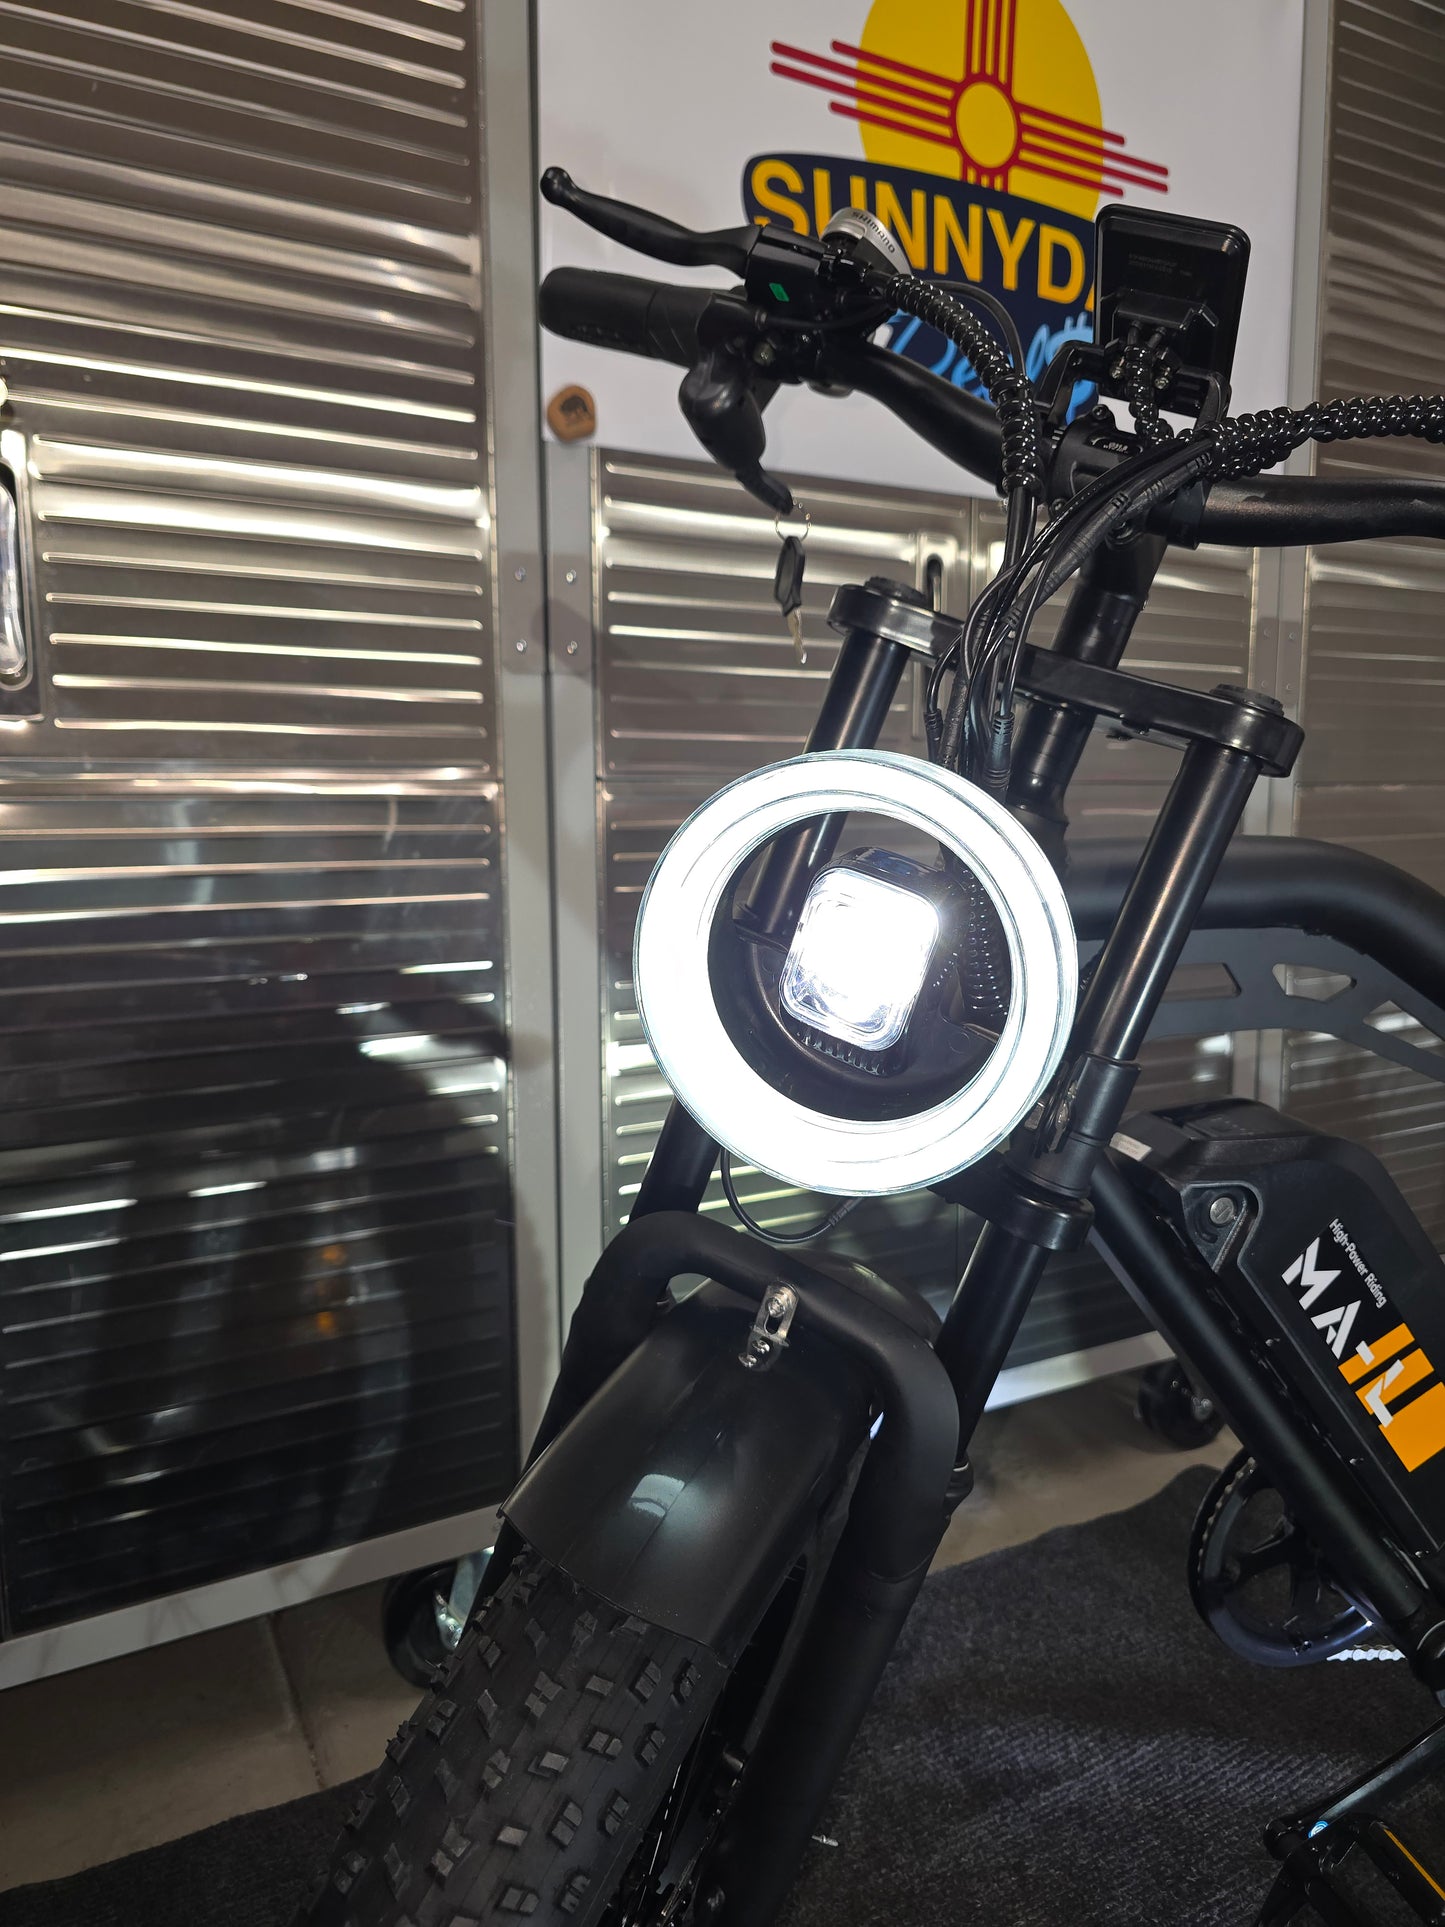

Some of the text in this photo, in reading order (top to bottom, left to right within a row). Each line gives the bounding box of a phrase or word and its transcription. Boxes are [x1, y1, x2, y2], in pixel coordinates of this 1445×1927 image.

[751, 159, 1095, 312] SUNNYD
[852, 211, 896, 254] SHIMANO
[1329, 1218, 1387, 1309] High-Power Riding
